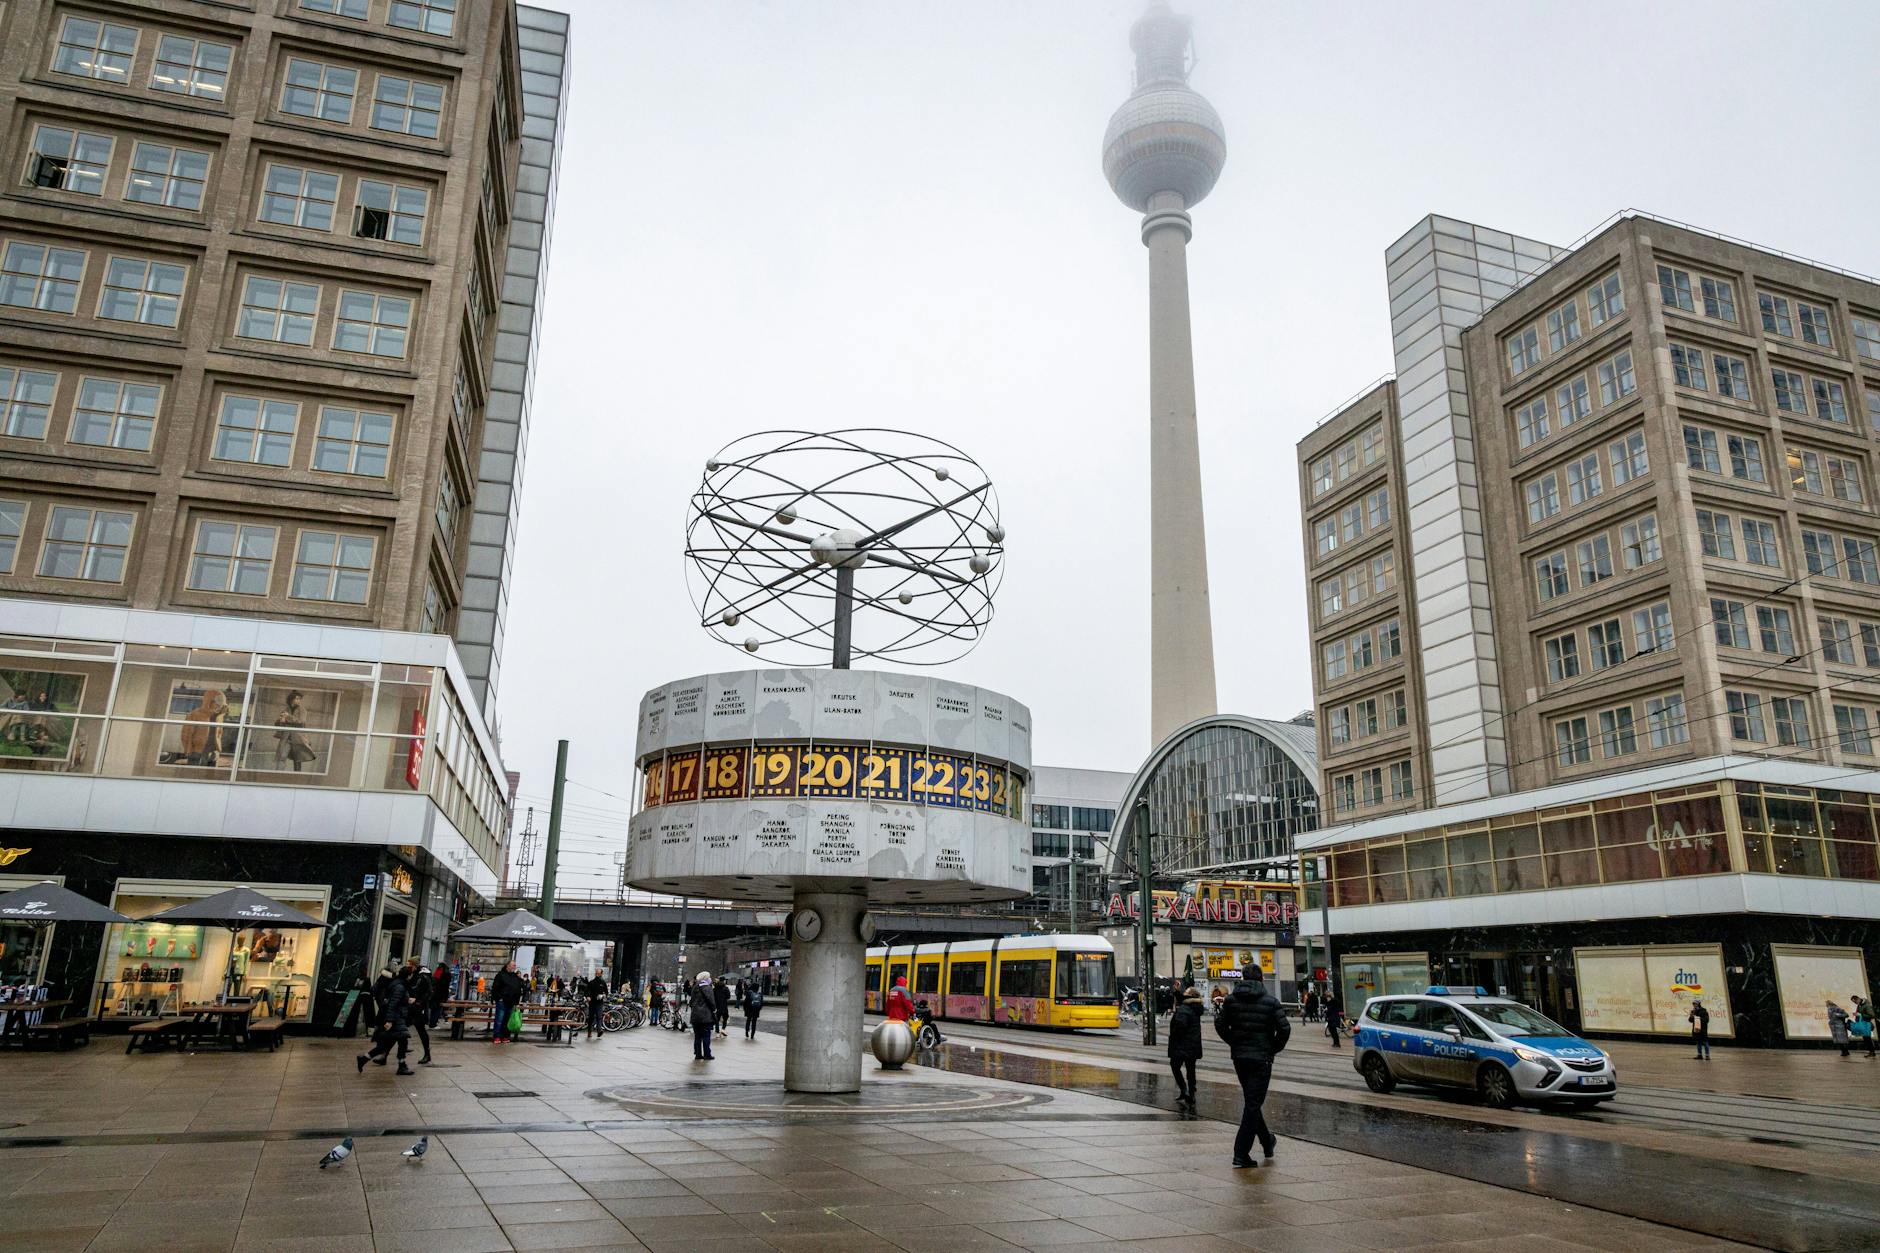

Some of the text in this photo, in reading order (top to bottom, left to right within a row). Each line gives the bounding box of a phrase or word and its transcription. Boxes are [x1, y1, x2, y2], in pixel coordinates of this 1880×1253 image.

[889, 690, 914, 698] JAKUTSK
[671, 759, 697, 792] 17
[706, 755, 738, 789] 18
[753, 753, 791, 786] 19
[800, 753, 851, 788] 20
[861, 756, 900, 789] 21
[912, 759, 954, 795] 22
[960, 766, 990, 801] 23
[820, 820, 855, 828] SHANGHAI
[1646, 820, 1693, 851] C&A
[237, 910, 284, 918] Tchibo
[1674, 968, 1698, 984] dm
[1433, 1044, 1468, 1059] POLIZEI
